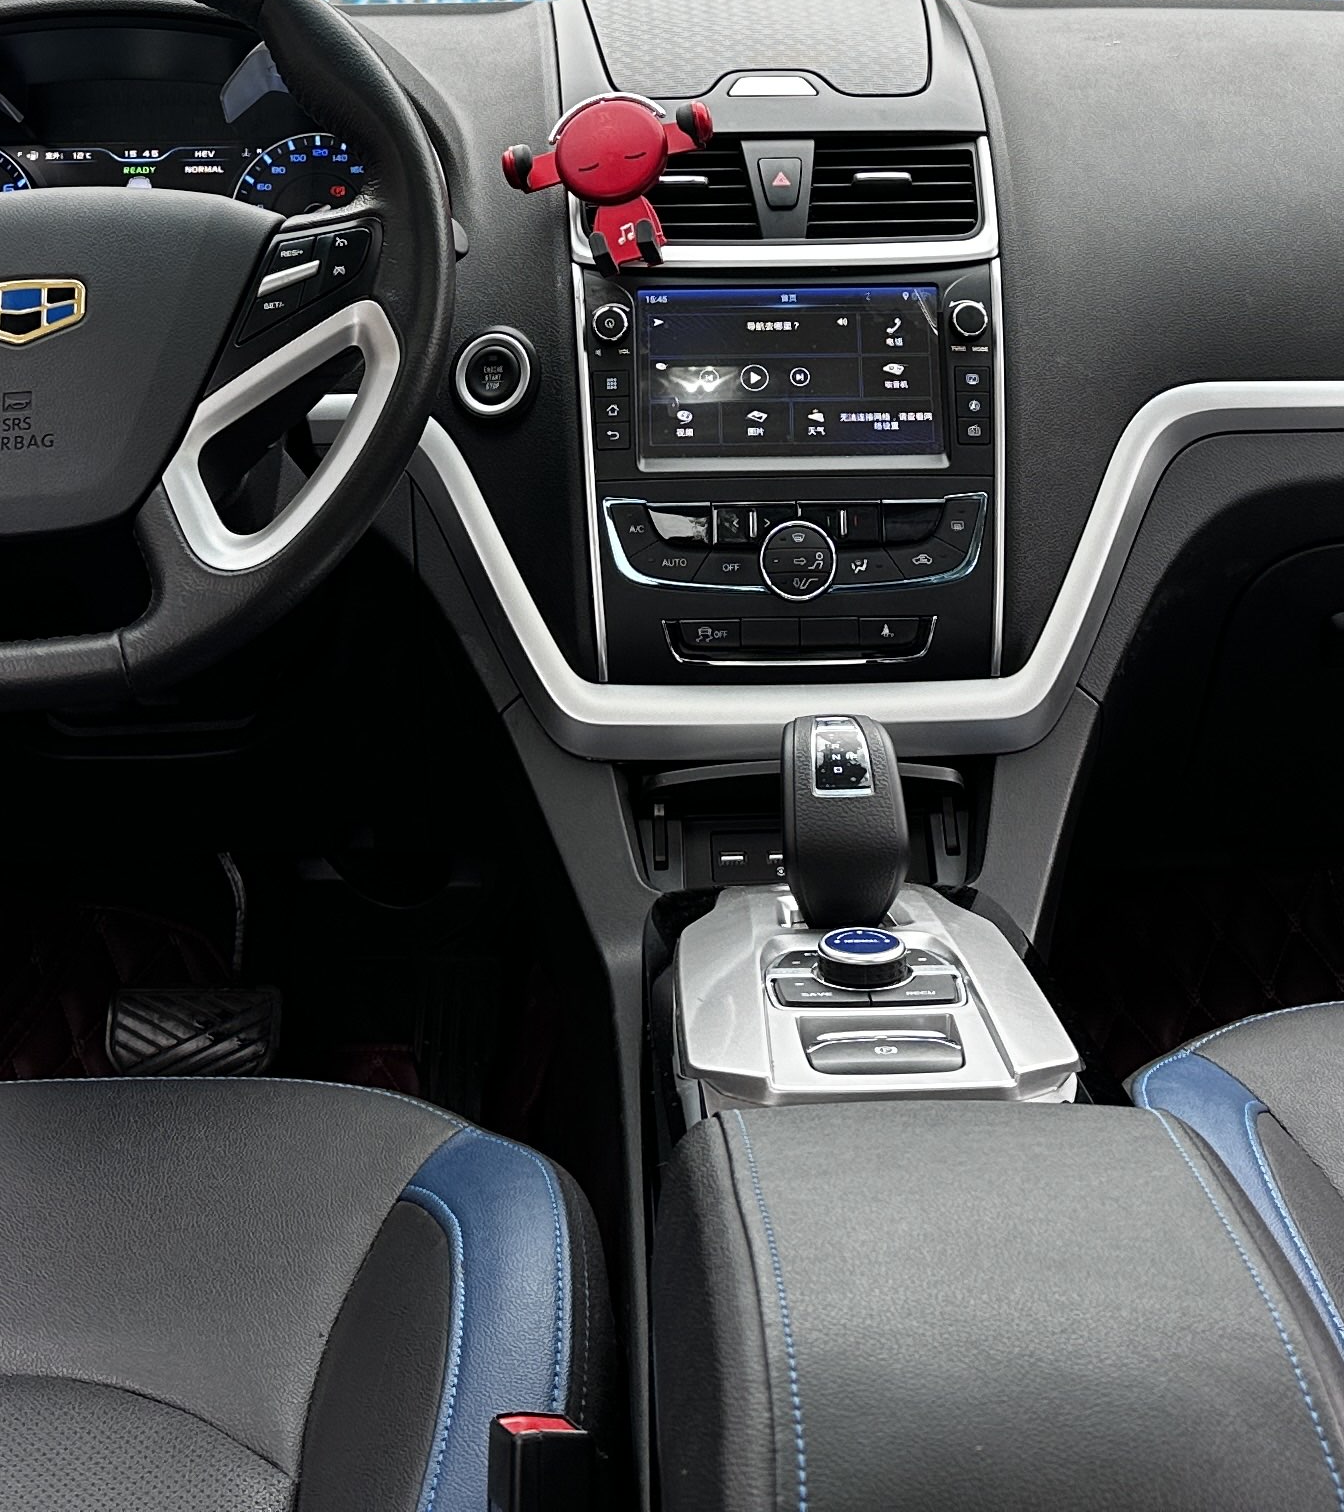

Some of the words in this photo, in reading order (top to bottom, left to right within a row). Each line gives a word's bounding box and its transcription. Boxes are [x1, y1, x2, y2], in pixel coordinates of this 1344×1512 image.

[312, 149, 329, 157] 120
[289, 154, 307, 162] 100
[332, 154, 348, 162] 140
[123, 166, 157, 174] READY
[184, 166, 225, 174] NORMAL
[271, 166, 286, 174] 80
[256, 183, 272, 191] 60
[2, 416, 32, 432] SRS
[807, 426, 825, 436] 天气
[629, 524, 645, 533] A/C
[661, 558, 688, 567] AUTO
[722, 563, 741, 572] OFF
[713, 630, 729, 639] OFF
[833, 766, 843, 774] D
